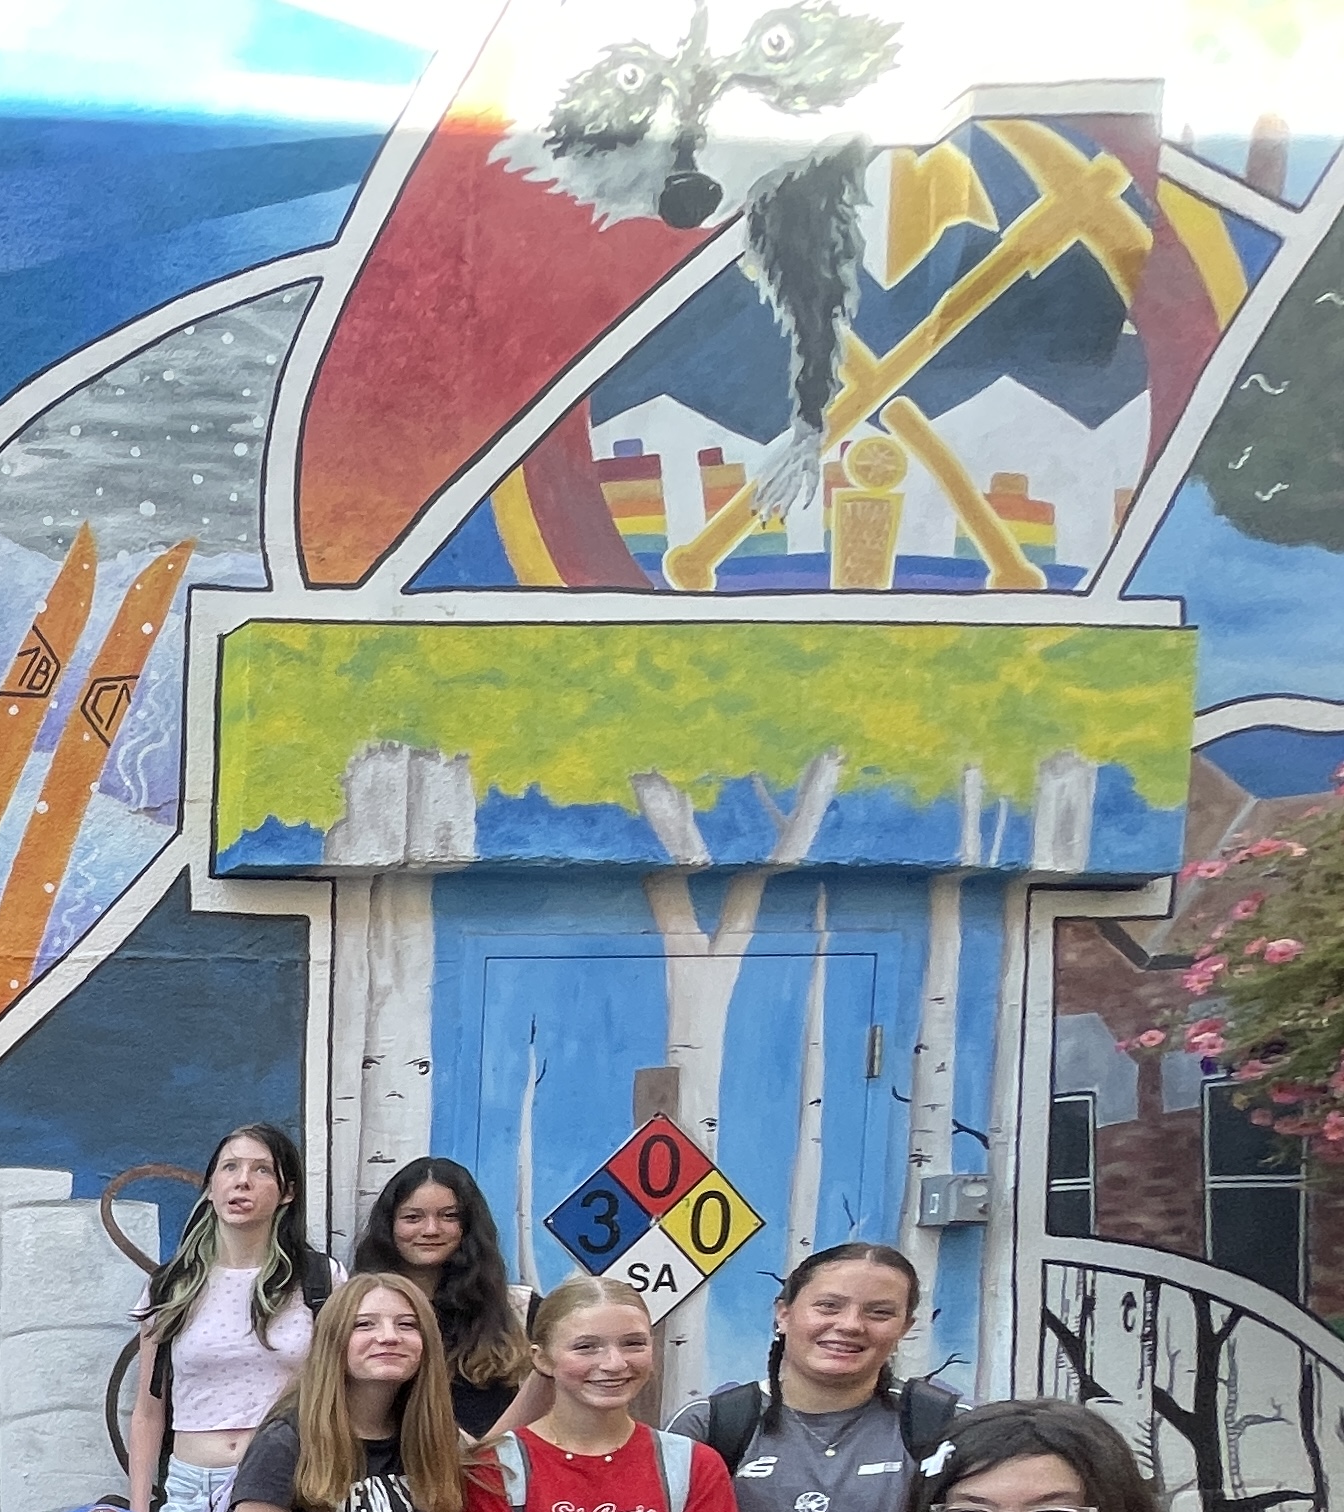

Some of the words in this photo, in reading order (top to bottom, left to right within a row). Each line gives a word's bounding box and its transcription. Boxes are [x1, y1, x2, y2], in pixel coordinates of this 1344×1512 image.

[638, 1134, 681, 1198] 0
[578, 1189, 621, 1255] 3
[690, 1190, 731, 1255] 0
[627, 1263, 678, 1293] SA
